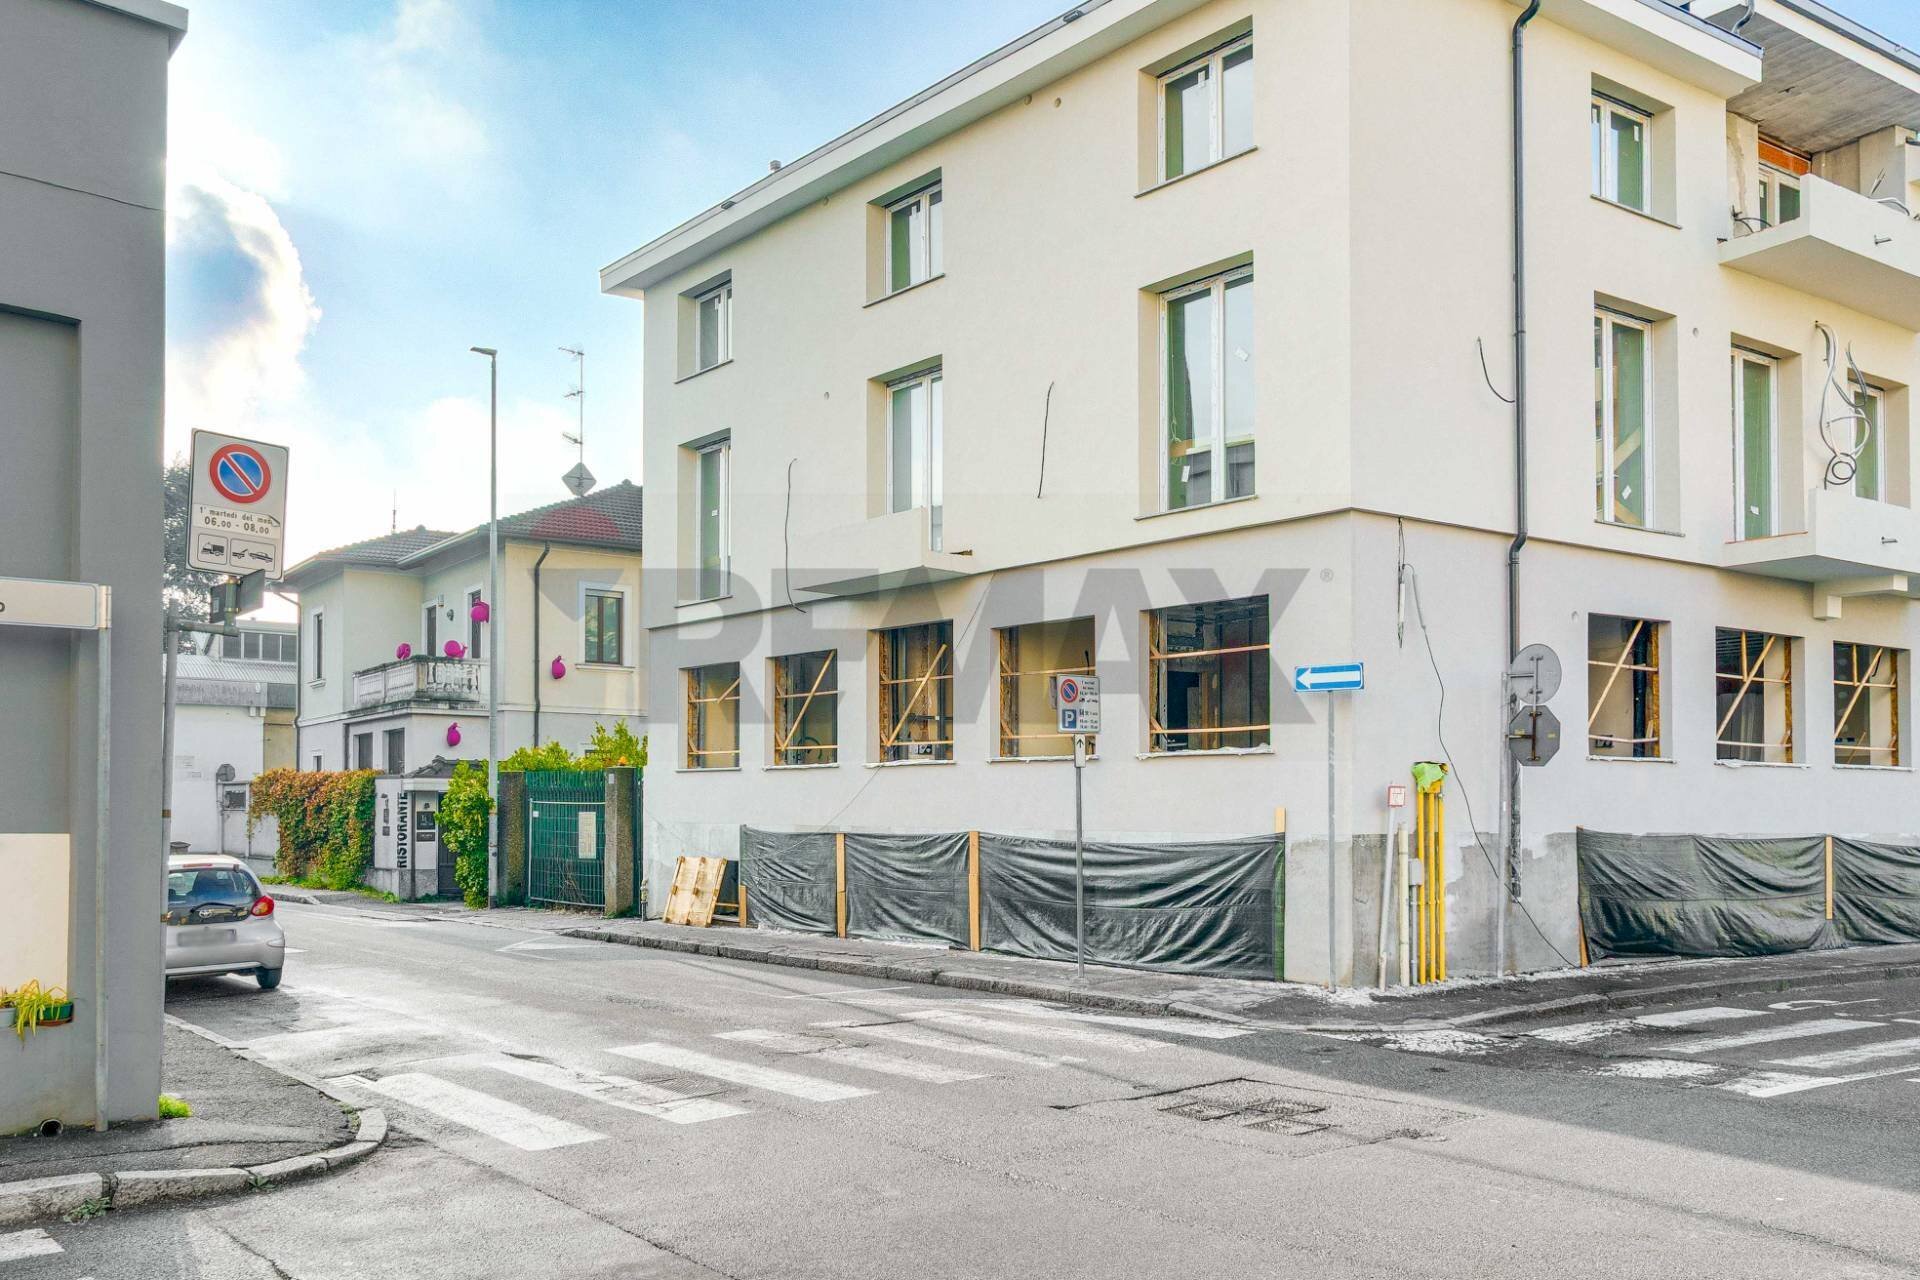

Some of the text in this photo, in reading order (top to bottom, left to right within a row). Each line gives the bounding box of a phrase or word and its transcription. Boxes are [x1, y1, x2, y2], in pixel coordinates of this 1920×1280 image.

[204, 516, 232, 528] 06.00
[243, 522, 269, 534] 08.00
[242, 513, 254, 522] del
[1065, 711, 1074, 727] P
[397, 792, 408, 868] RISTORANTE
